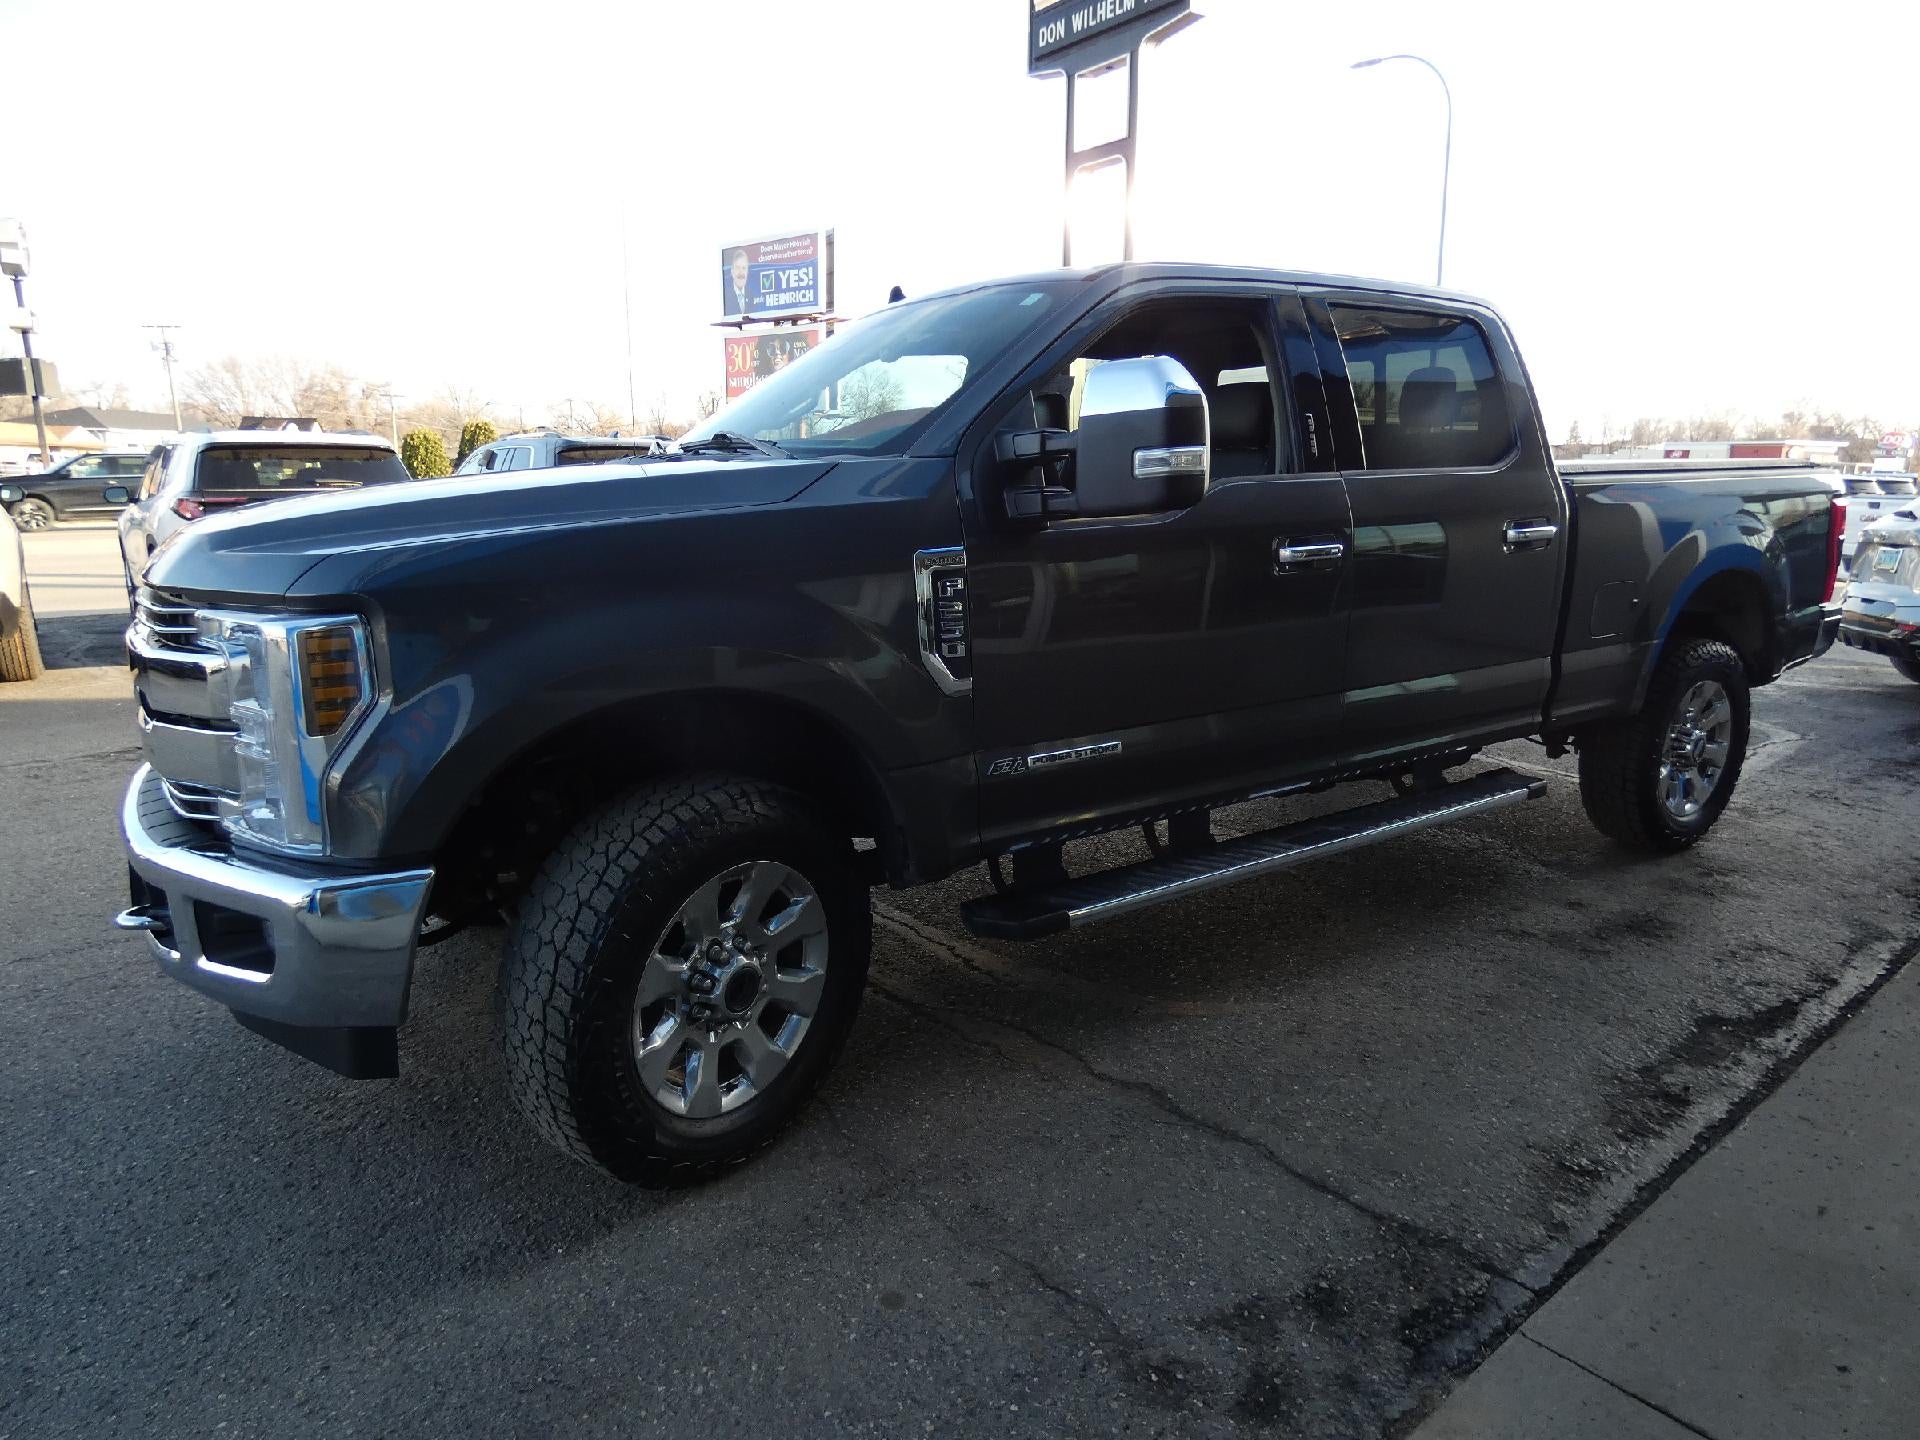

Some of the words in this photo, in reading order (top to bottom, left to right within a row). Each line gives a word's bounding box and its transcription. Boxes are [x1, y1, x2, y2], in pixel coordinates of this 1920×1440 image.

[1039, 18, 1066, 47] DON
[1072, 0, 1135, 33] WILHELM
[777, 266, 814, 289] YES!
[765, 289, 814, 307] HEINRICH
